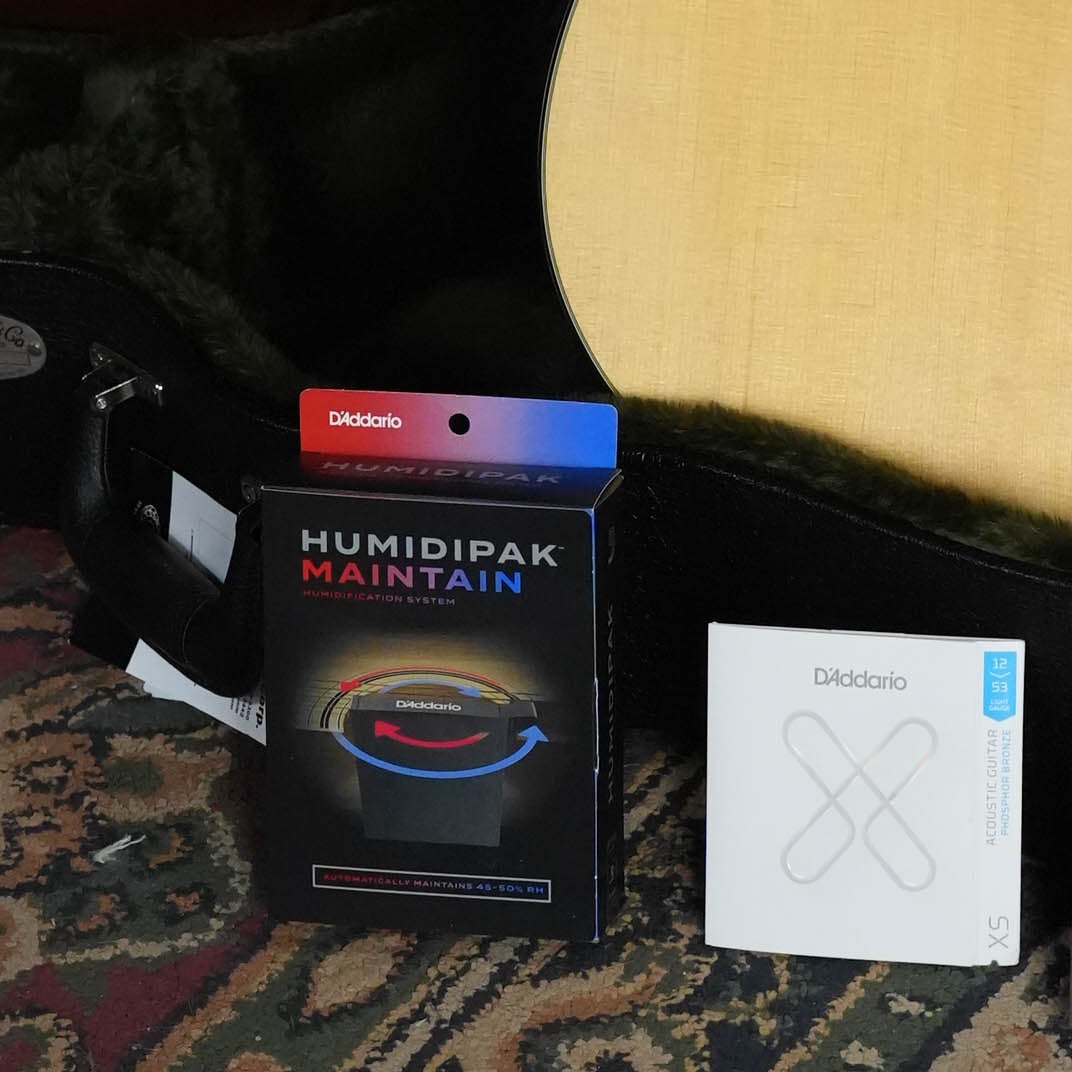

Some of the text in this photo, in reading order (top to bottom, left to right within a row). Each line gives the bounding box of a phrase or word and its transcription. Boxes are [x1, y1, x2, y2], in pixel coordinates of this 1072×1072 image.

[329, 410, 402, 429] D'Addario
[321, 461, 560, 484] HUMIDIPAK
[301, 529, 558, 567] HUMIDIPAK
[302, 559, 522, 594] MAINTAIN
[303, 589, 456, 606] HUMIDIFICATION SYSTEM
[992, 657, 1008, 669] 12
[814, 667, 907, 691] D'Addario
[992, 681, 1008, 693] 53
[396, 700, 462, 712] D'Addario
[986, 729, 998, 846] ACOUSTIC GUITAR
[1001, 730, 1011, 837] PHOSPHOR BRONZE
[323, 874, 411, 886] AUTOMATICALLY
[413, 880, 473, 890] MAINTAINS
[527, 885, 544, 894] RH
[988, 915, 1008, 949] XS
